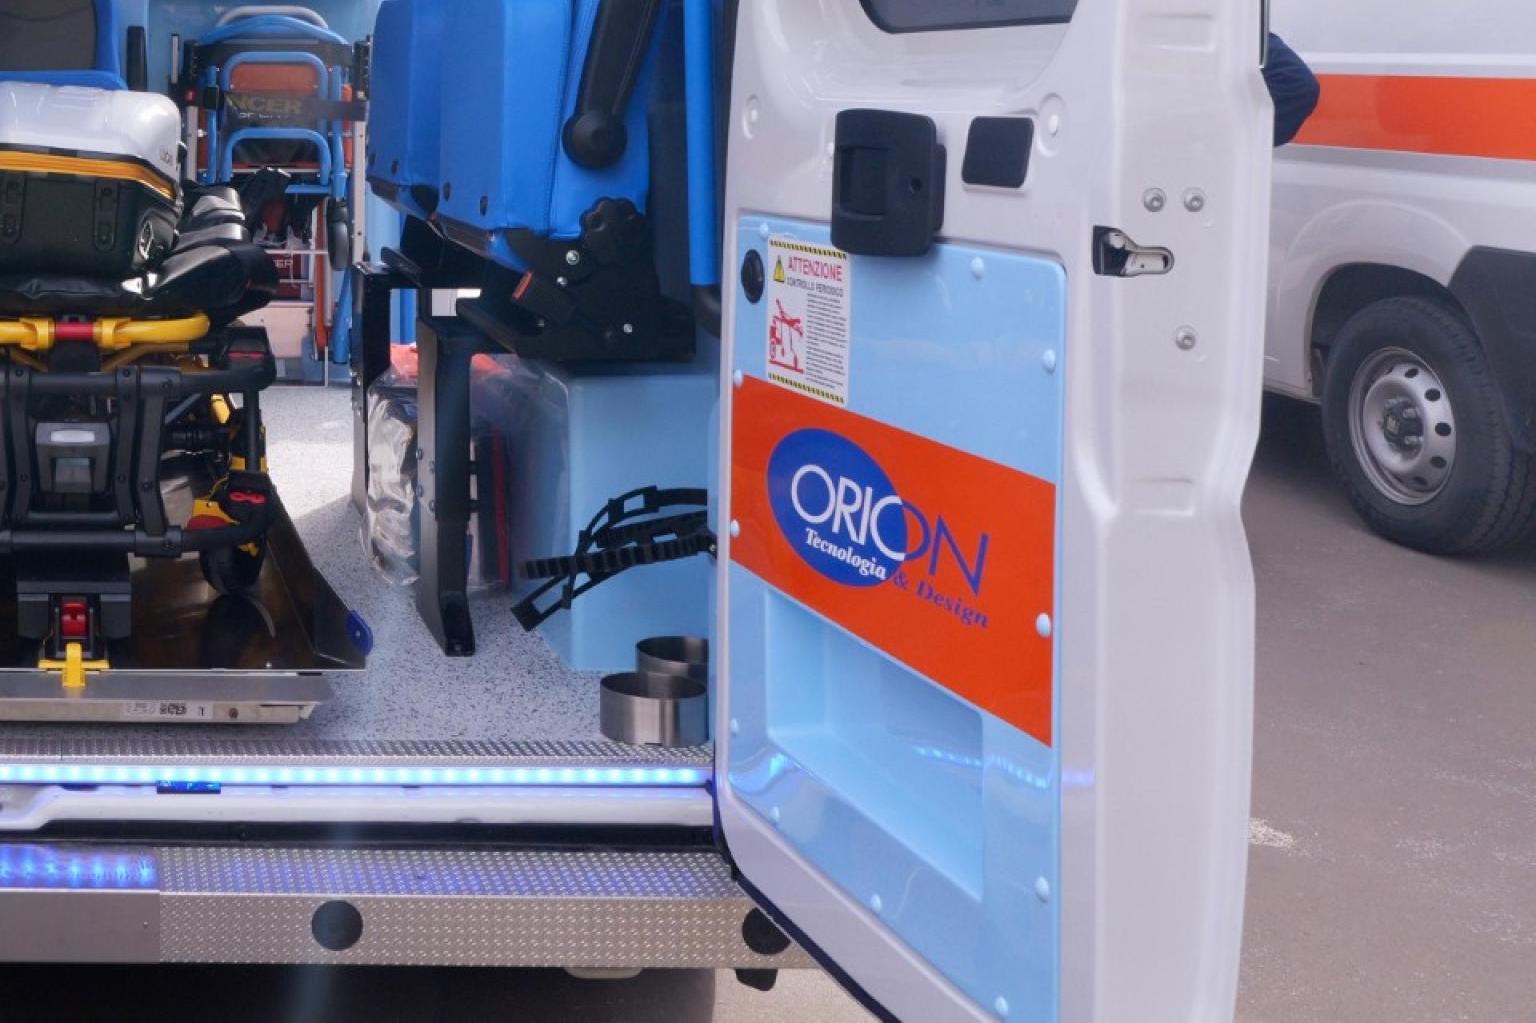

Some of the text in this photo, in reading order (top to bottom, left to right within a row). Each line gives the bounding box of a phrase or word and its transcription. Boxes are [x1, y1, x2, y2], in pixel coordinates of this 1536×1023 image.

[787, 256, 843, 282] ATTENZIONE
[791, 464, 990, 596] ORION
[804, 527, 990, 630] Tecnologia & Design
